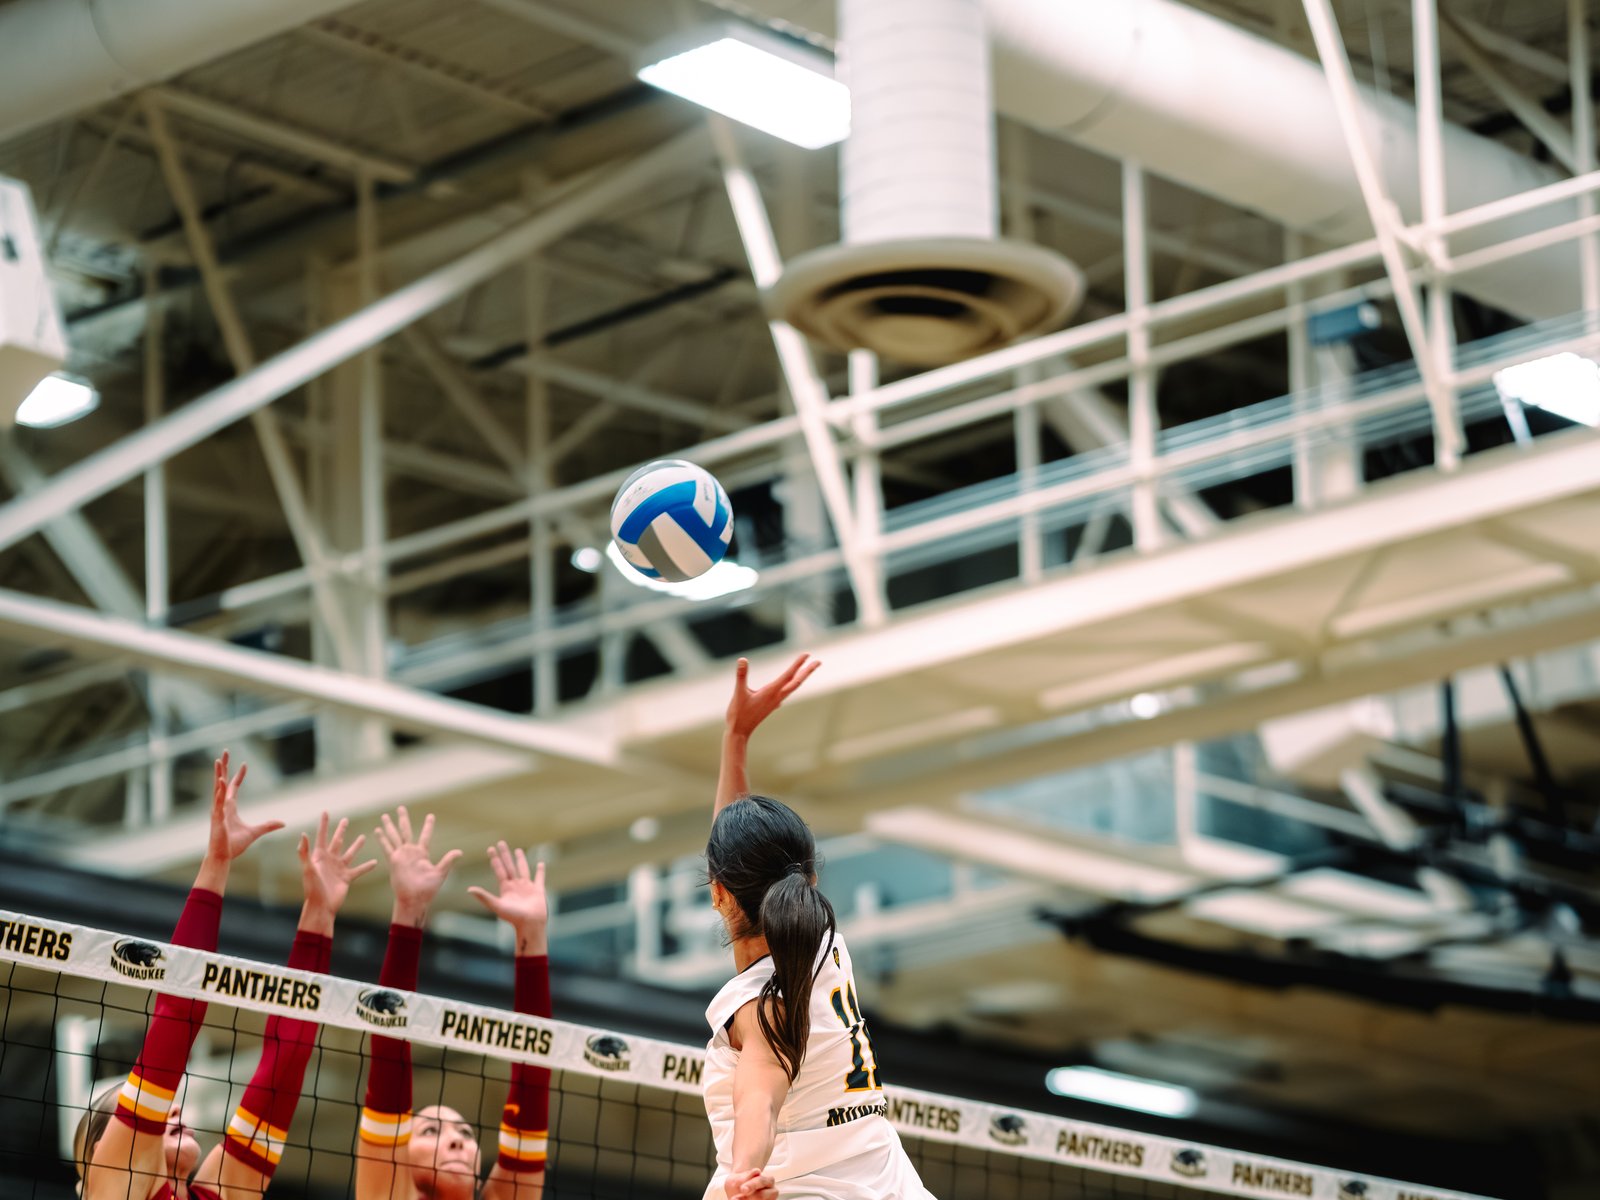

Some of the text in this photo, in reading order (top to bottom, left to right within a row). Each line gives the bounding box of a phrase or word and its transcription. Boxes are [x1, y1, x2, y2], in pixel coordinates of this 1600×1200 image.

[110, 955, 166, 981] MILWAUKEE
[201, 962, 321, 1012] PANTHERS
[441, 1009, 553, 1056] PANTHERS
[662, 1053, 704, 1085] PAN
[1056, 1129, 1145, 1167] PANTHERS
